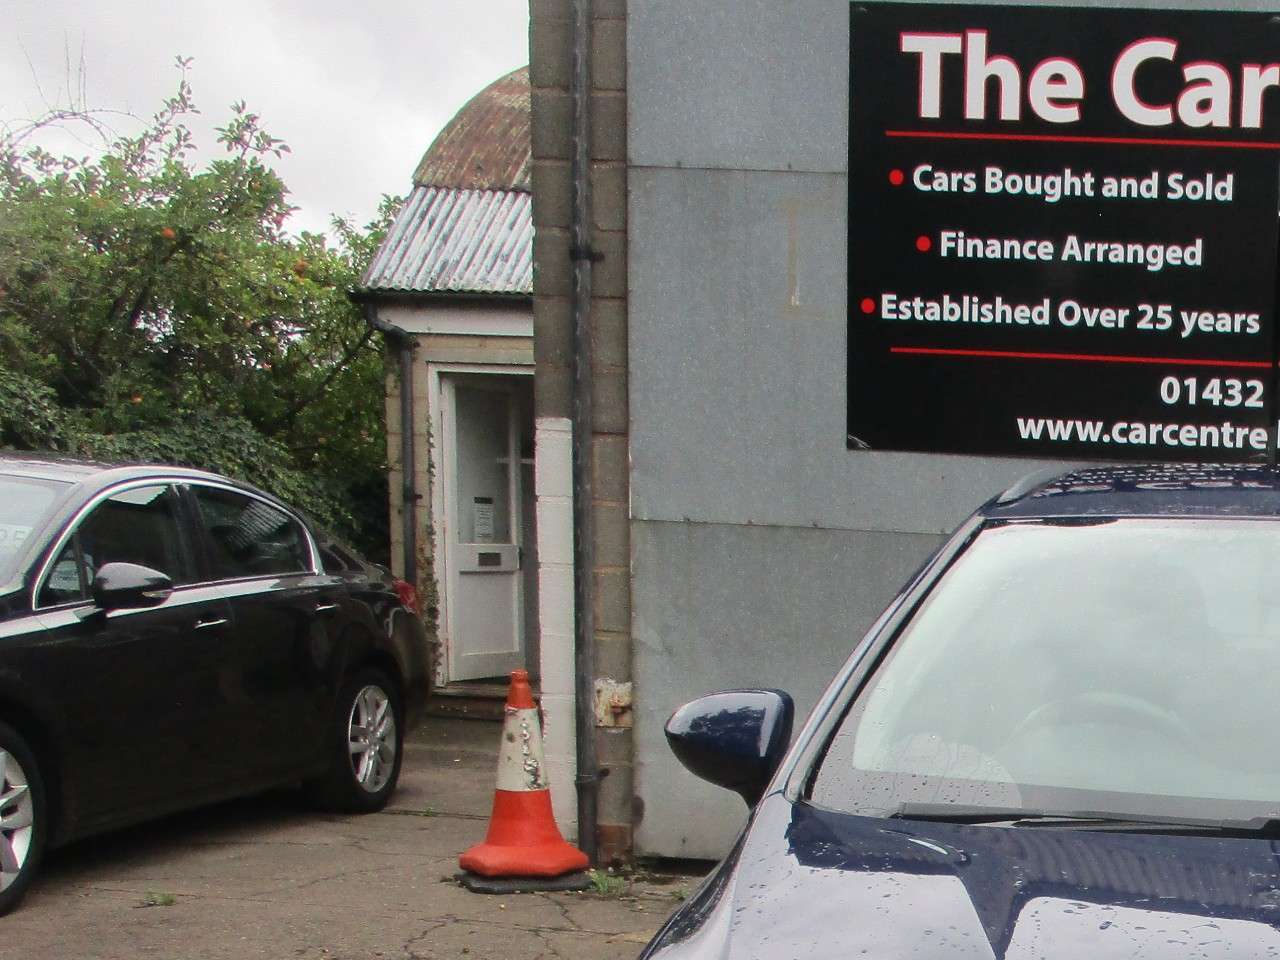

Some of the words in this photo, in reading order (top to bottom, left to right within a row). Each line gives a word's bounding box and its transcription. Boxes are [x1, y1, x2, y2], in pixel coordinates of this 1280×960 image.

[901, 29, 1085, 124] The
[1111, 37, 1280, 129] Car
[912, 164, 977, 193] Cars
[984, 166, 1095, 203] Bought
[1101, 171, 1159, 199] and
[1166, 172, 1234, 201] Sold
[940, 230, 1054, 261] Finance
[1060, 235, 1203, 272] Arranged
[881, 293, 1050, 326] Established
[1057, 300, 1130, 328] Over
[1136, 303, 1173, 330] 25
[1180, 311, 1260, 339] years
[1160, 376, 1264, 408] 01432
